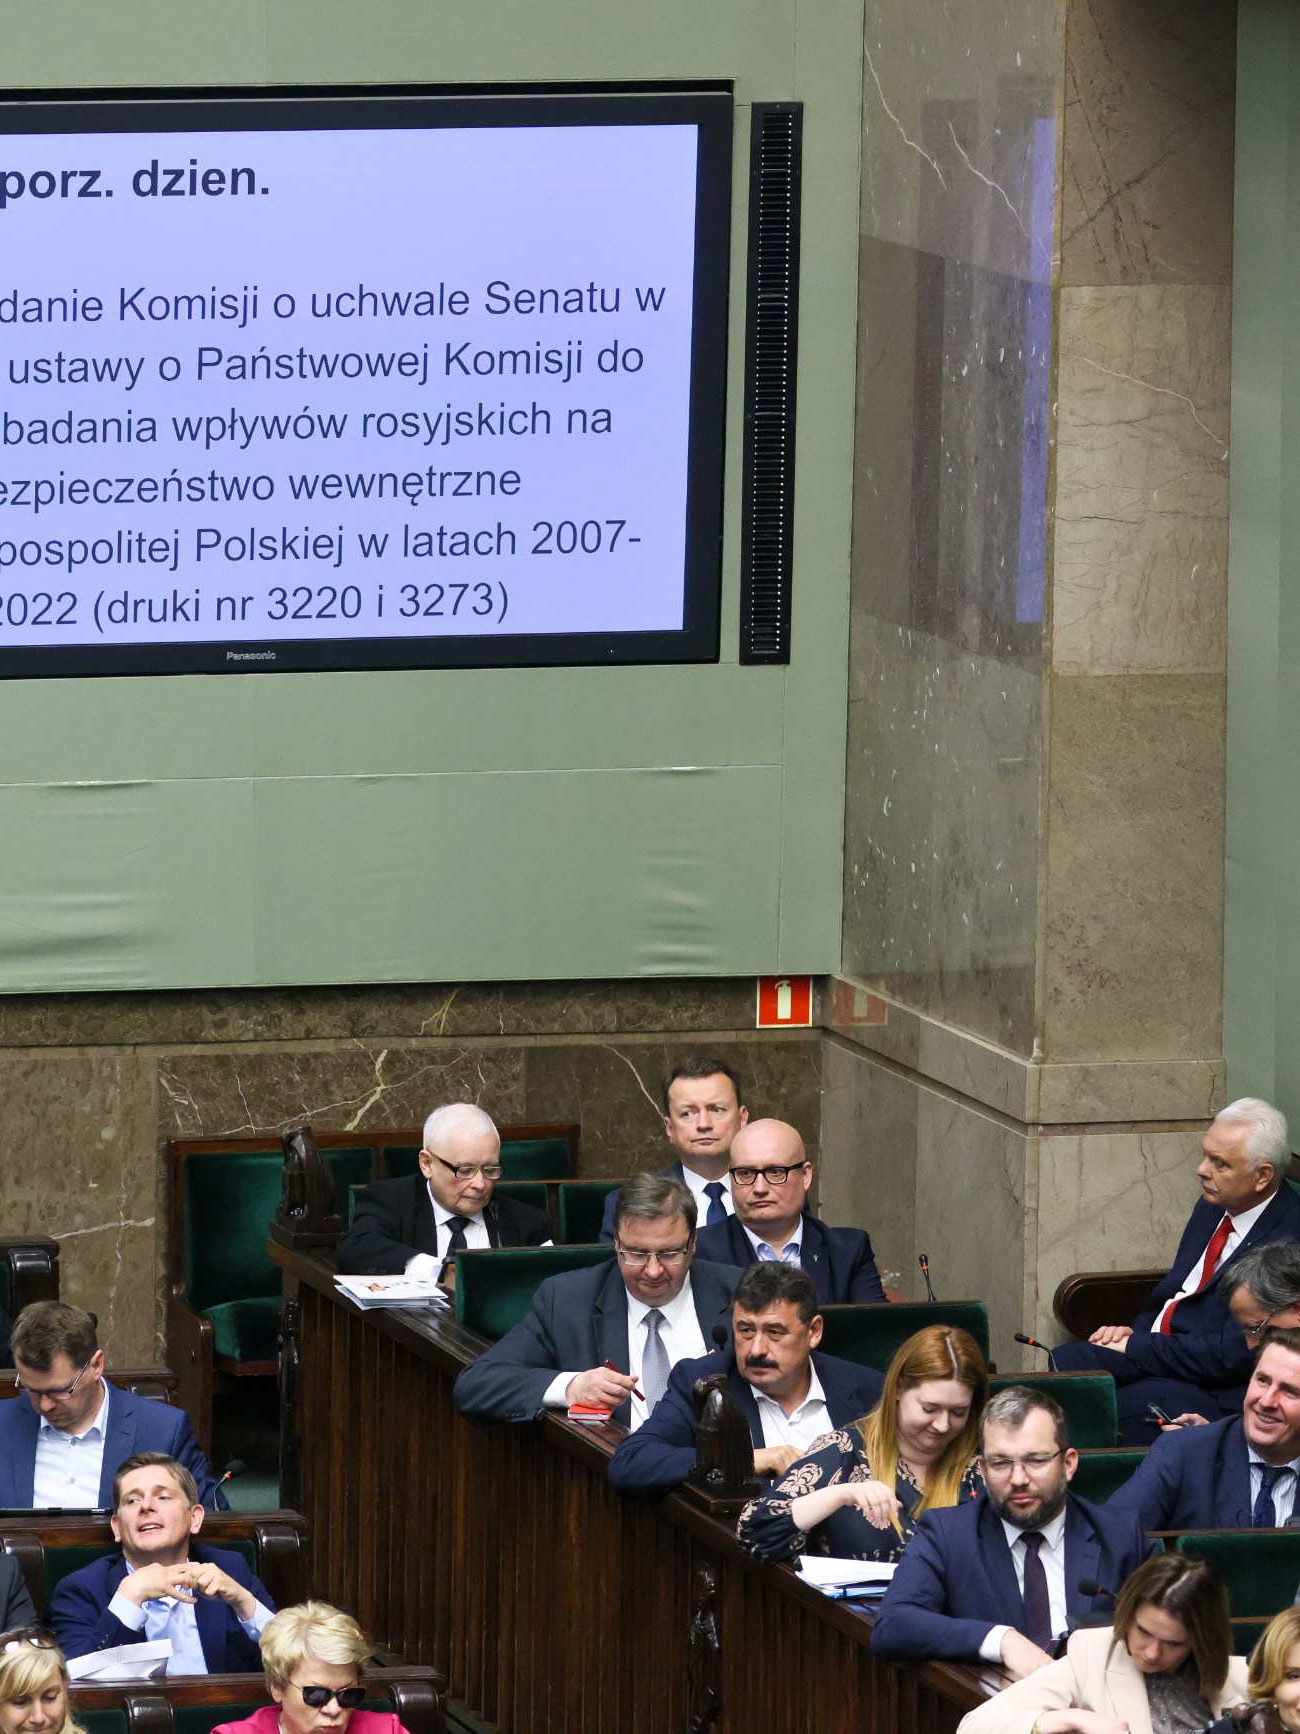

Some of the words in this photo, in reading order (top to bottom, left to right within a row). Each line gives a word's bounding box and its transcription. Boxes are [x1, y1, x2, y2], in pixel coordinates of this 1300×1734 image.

[131, 158, 270, 198] dzien.
[119, 285, 258, 329] Komisji
[273, 293, 296, 319] o
[311, 281, 470, 319] uchwale
[484, 280, 621, 315] Senatu
[634, 286, 667, 312] w
[8, 350, 146, 392] ustawy
[158, 355, 182, 382] o
[197, 342, 429, 387] Państwowej
[444, 339, 583, 384] Komisji
[597, 339, 644, 374] do
[2, 408, 158, 446] badania
[171, 405, 349, 451] wpływów
[362, 401, 551, 447] rosyjskich
[567, 408, 612, 434] na
[288, 464, 522, 507] wewnętrzne
[195, 524, 344, 569] Polskiej
[357, 533, 390, 559] w
[403, 521, 516, 558] latach
[530, 519, 642, 555] 2007-
[93, 588, 200, 634] (druki
[216, 595, 255, 622] nr
[266, 584, 362, 621] 3220
[377, 584, 384, 618] i
[398, 580, 509, 625] 3273)
[226, 651, 277, 661] Panasonic
